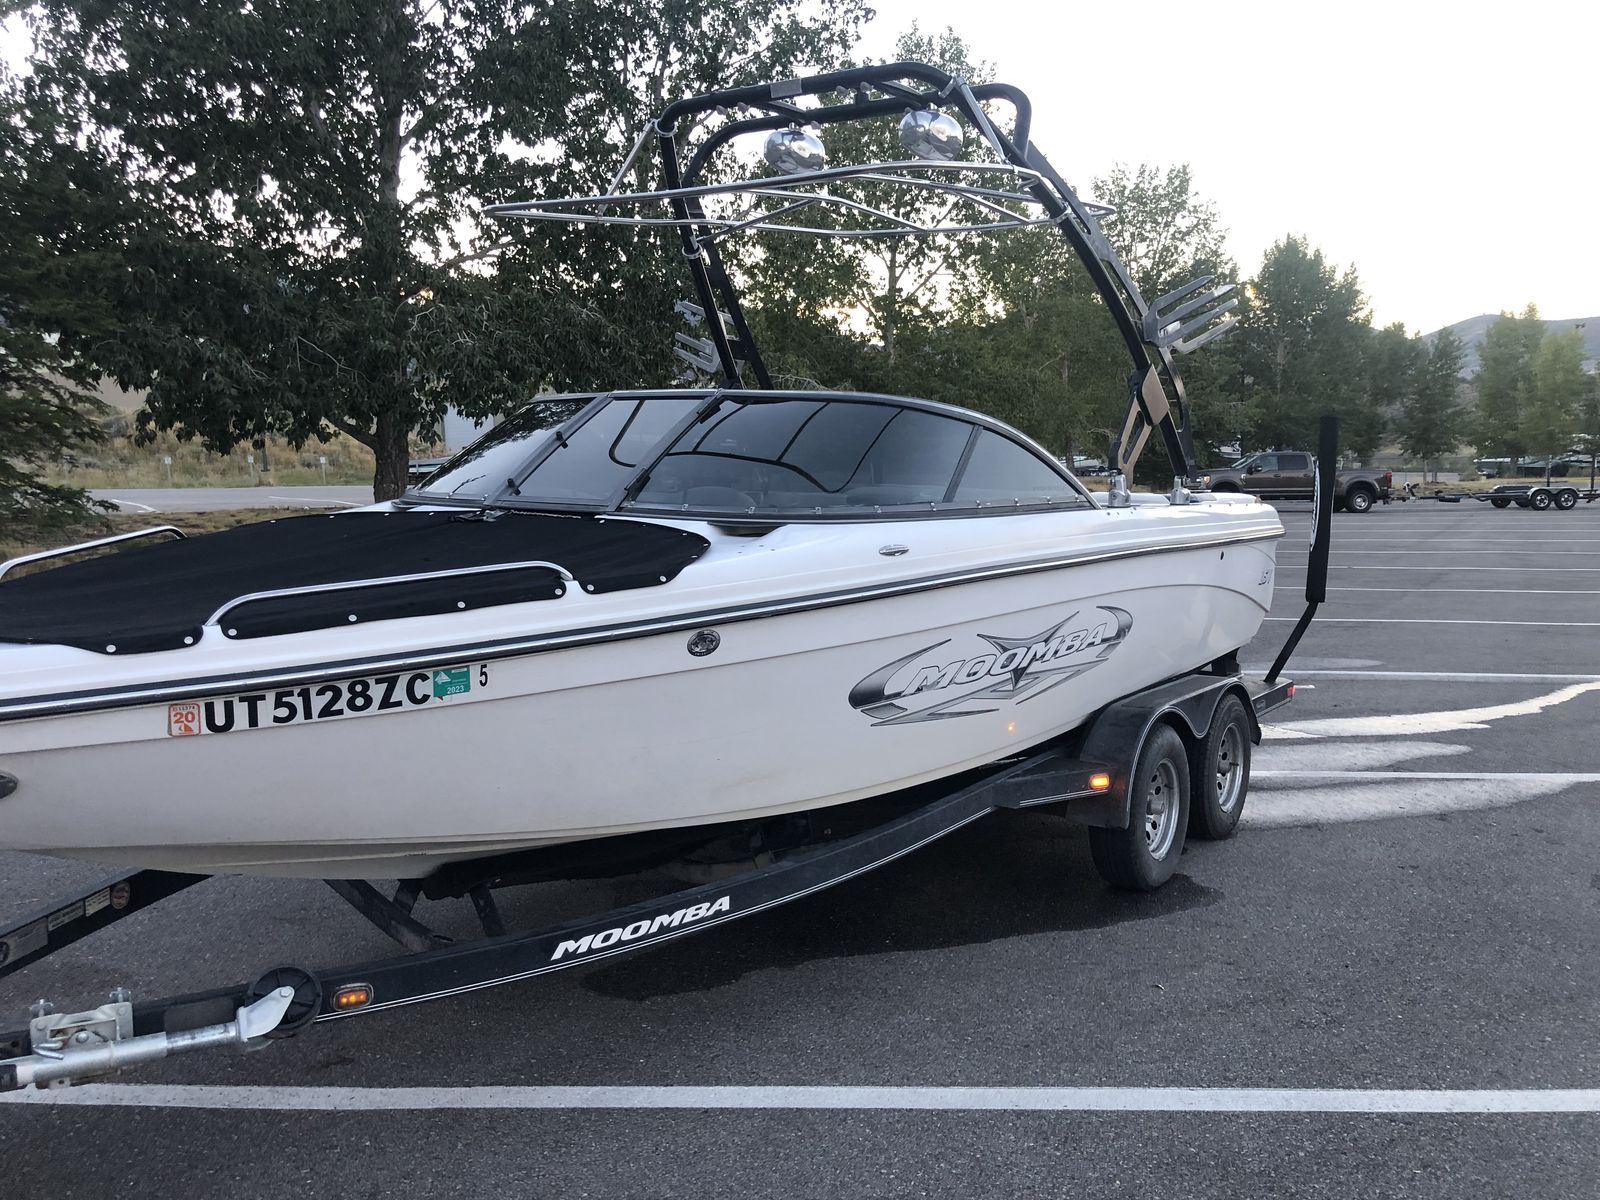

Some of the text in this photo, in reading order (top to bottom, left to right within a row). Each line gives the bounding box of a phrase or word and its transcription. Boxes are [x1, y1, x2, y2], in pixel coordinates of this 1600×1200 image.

[902, 622, 1108, 695] MOOMBA
[479, 663, 489, 687] 5
[447, 685, 465, 694] 2023
[174, 711, 196, 724] 20
[550, 895, 730, 961] MOOMBA
